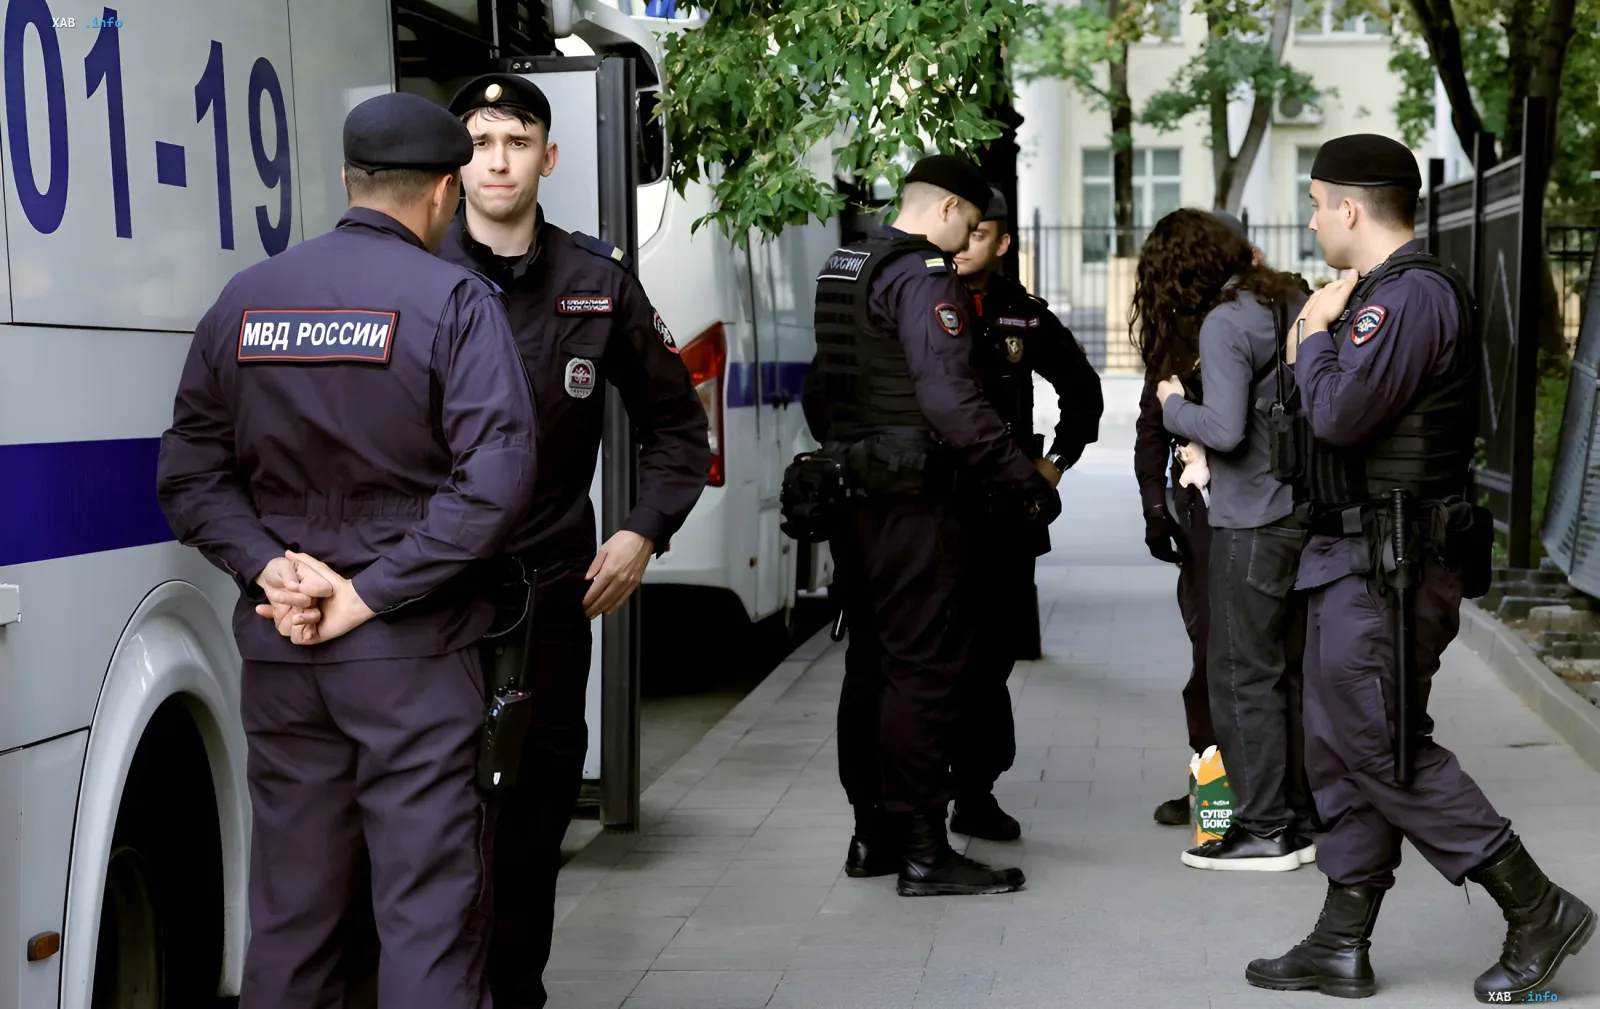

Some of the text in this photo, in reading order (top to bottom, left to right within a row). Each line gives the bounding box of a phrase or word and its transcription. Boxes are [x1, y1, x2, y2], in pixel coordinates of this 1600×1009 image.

[4, 0, 292, 257] 01-19
[243, 322, 389, 350] МВД РОССИИ
[1200, 810, 1232, 818] СУПЕР
[1203, 819, 1230, 828] БОКС
